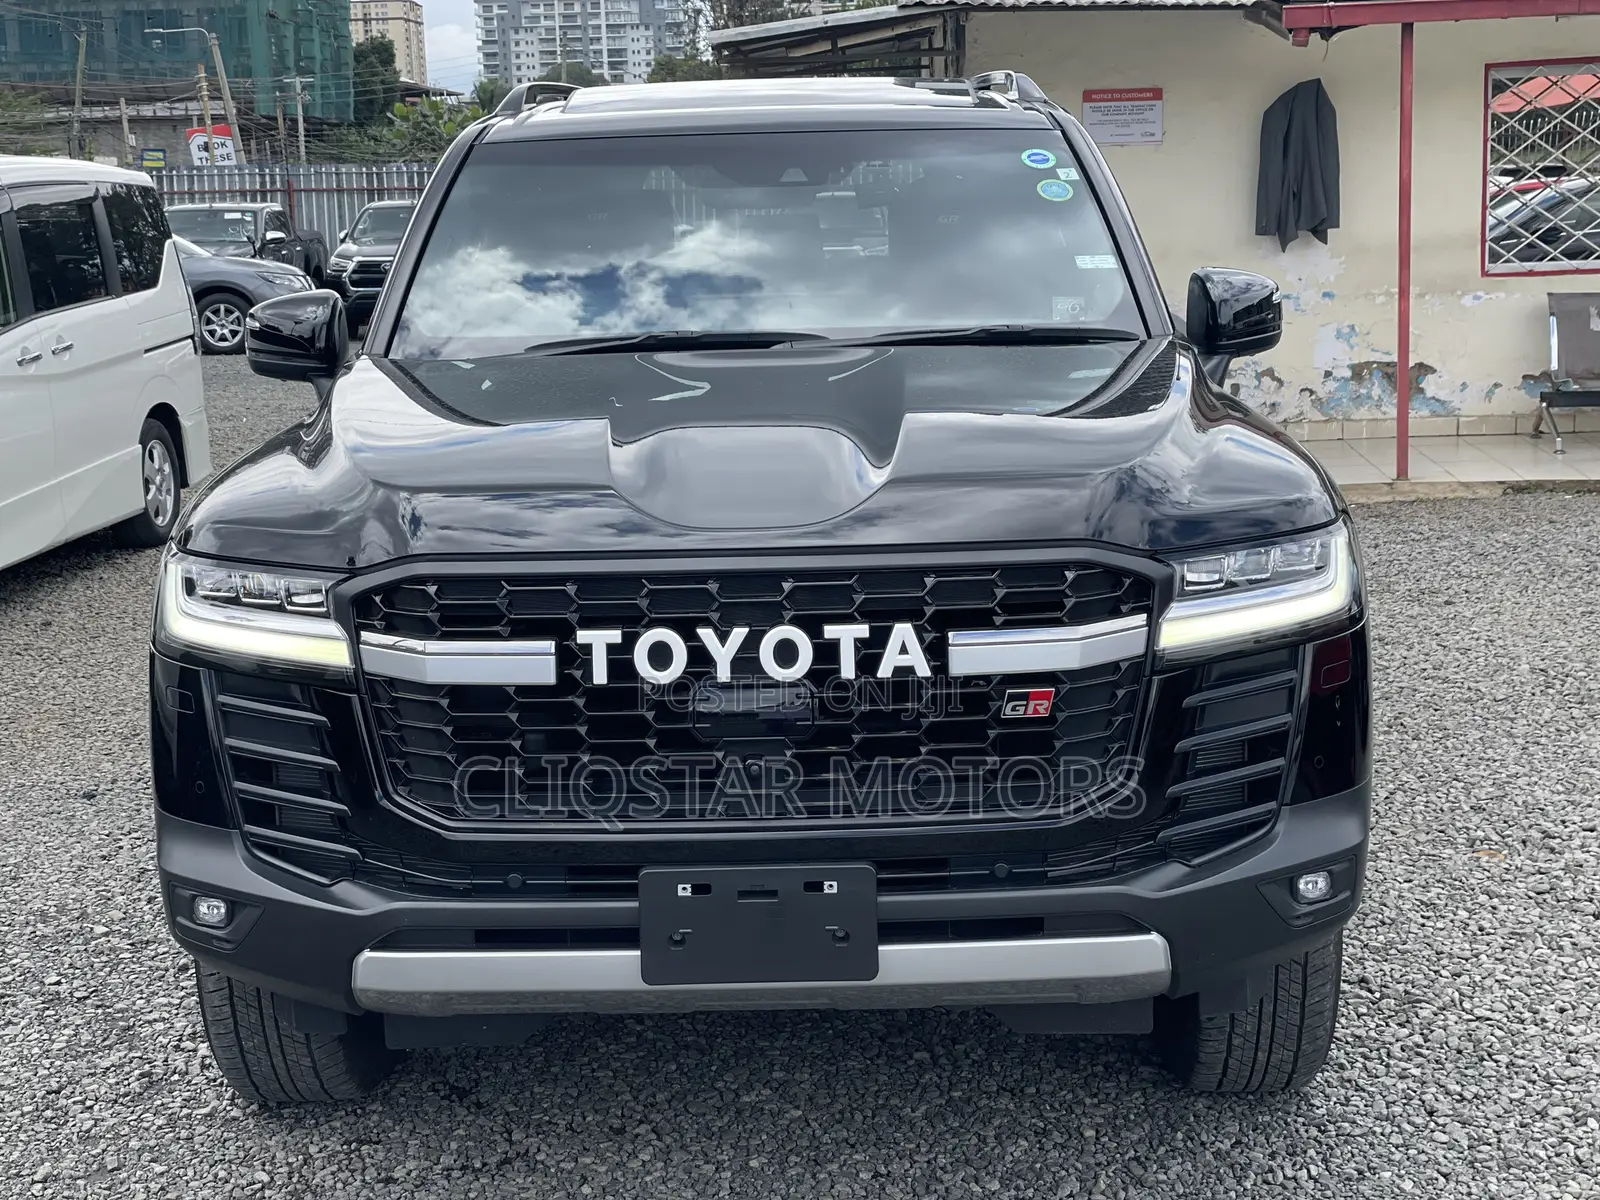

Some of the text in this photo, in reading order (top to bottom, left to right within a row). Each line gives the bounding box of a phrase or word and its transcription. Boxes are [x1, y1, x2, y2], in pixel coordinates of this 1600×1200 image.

[197, 140, 228, 152] BOK
[576, 623, 932, 685] TOYOTA
[1004, 700, 1049, 715] GR
